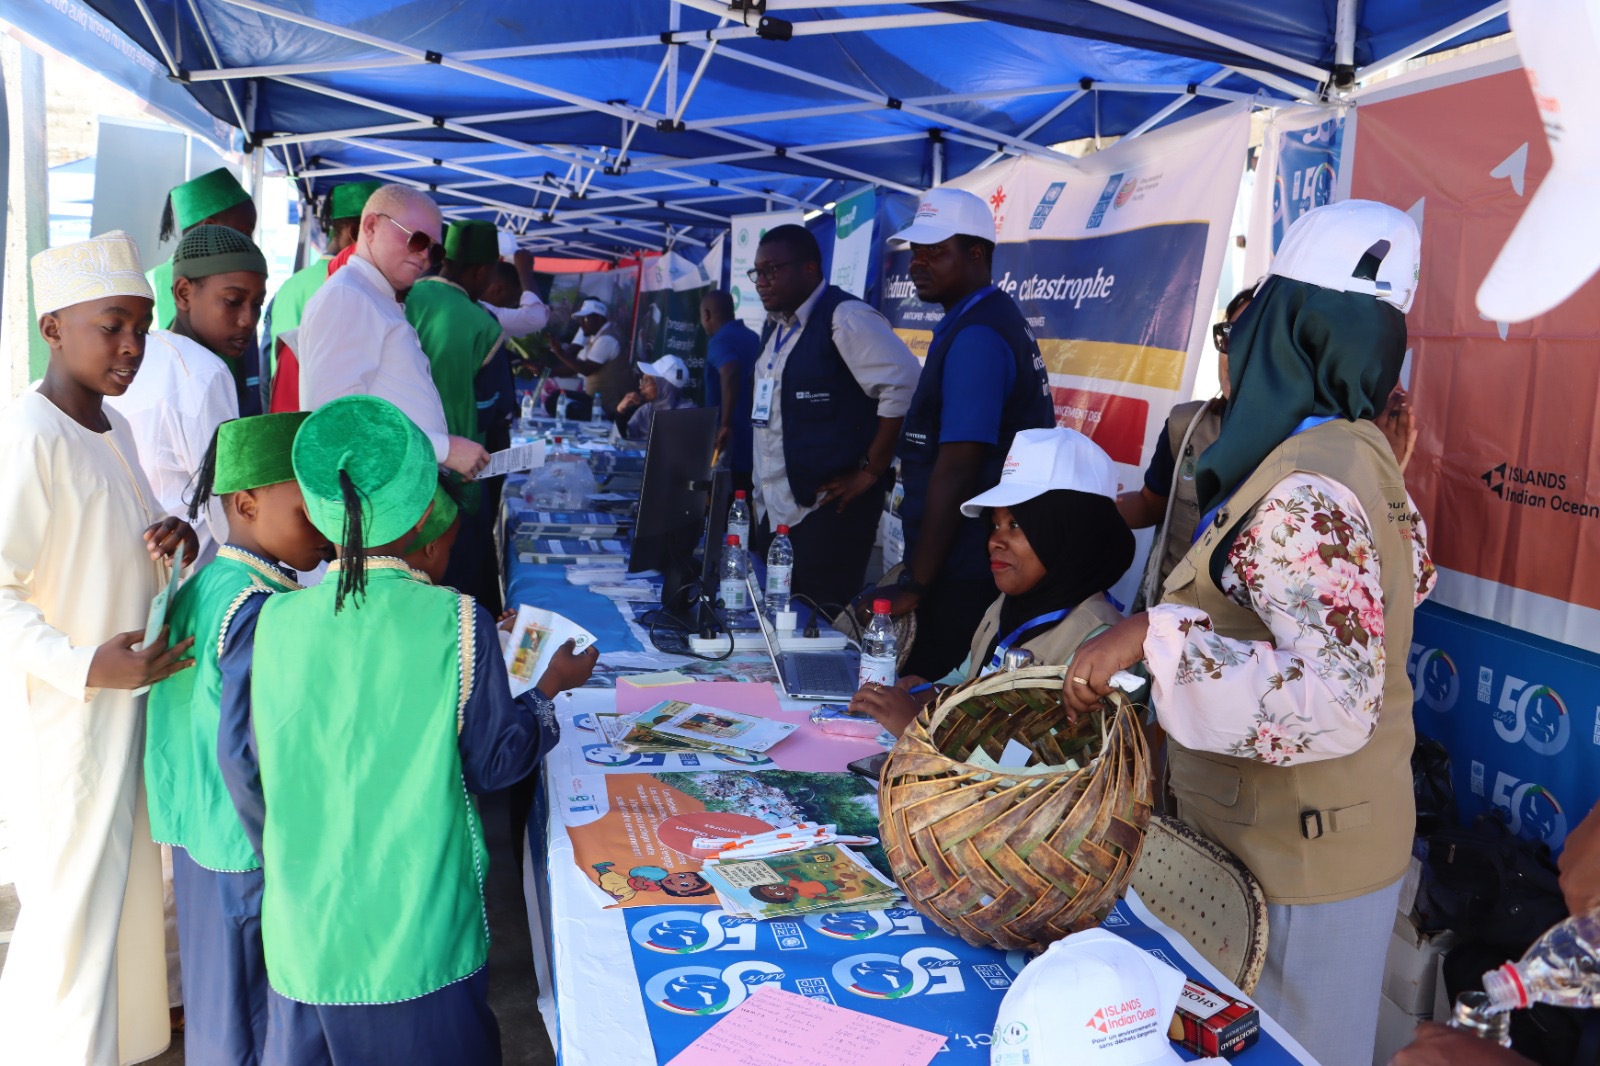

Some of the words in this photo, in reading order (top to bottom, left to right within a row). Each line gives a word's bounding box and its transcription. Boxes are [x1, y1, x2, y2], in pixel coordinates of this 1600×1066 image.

[998, 272, 1016, 297] de
[1019, 267, 1115, 309] catastrophe
[1508, 466, 1567, 490] ISLANDS
[1505, 486, 1546, 508] Indian
[1550, 495, 1600, 518] Ocean
[1493, 674, 1571, 756] 50
[832, 947, 965, 1000] 50
[1104, 998, 1142, 1018] ISLANDS
[1107, 1014, 1138, 1030] Indian
[1137, 1007, 1157, 1021] Ocean
[1091, 1037, 1108, 1045] Pour
[1098, 1041, 1114, 1050] sans
[1114, 1035, 1137, 1046] déchets
[1220, 1025, 1259, 1051] SHORTBREAD
